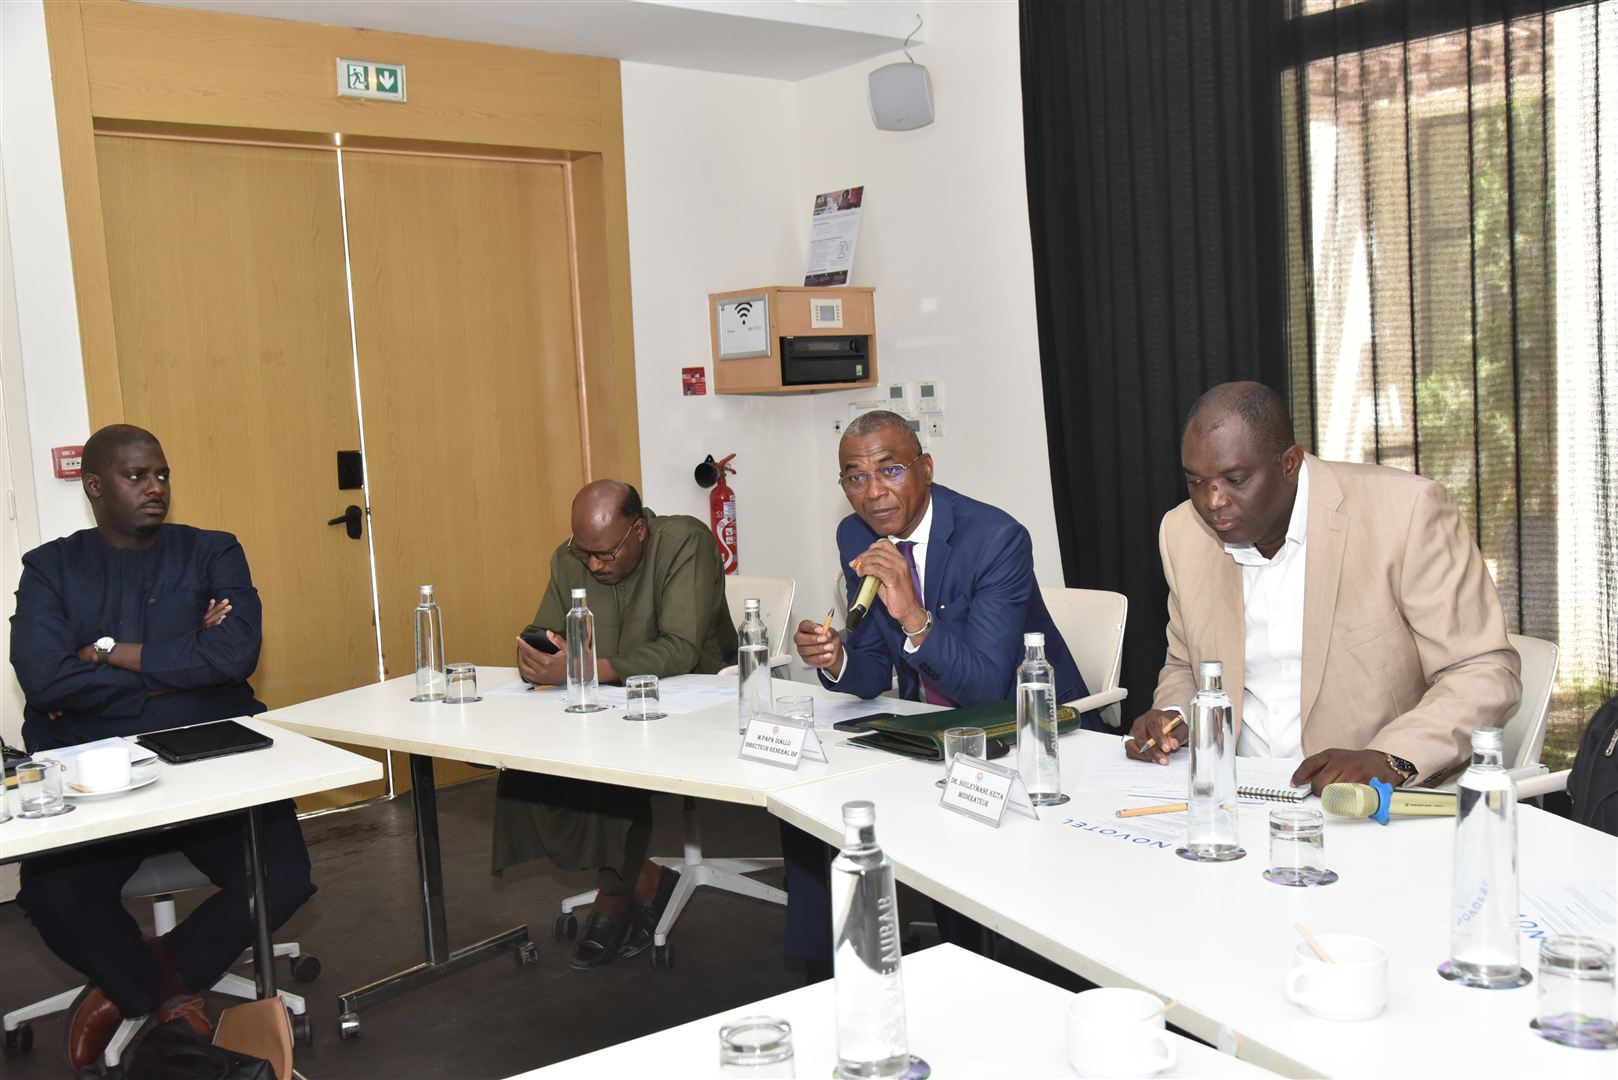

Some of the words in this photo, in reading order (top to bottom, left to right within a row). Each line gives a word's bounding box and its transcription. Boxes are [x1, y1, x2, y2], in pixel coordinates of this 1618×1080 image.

[745, 741, 769, 752] DIRECTEUR
[989, 789, 1004, 800] KEITA
[1062, 818, 1173, 849] NOVOTEL
